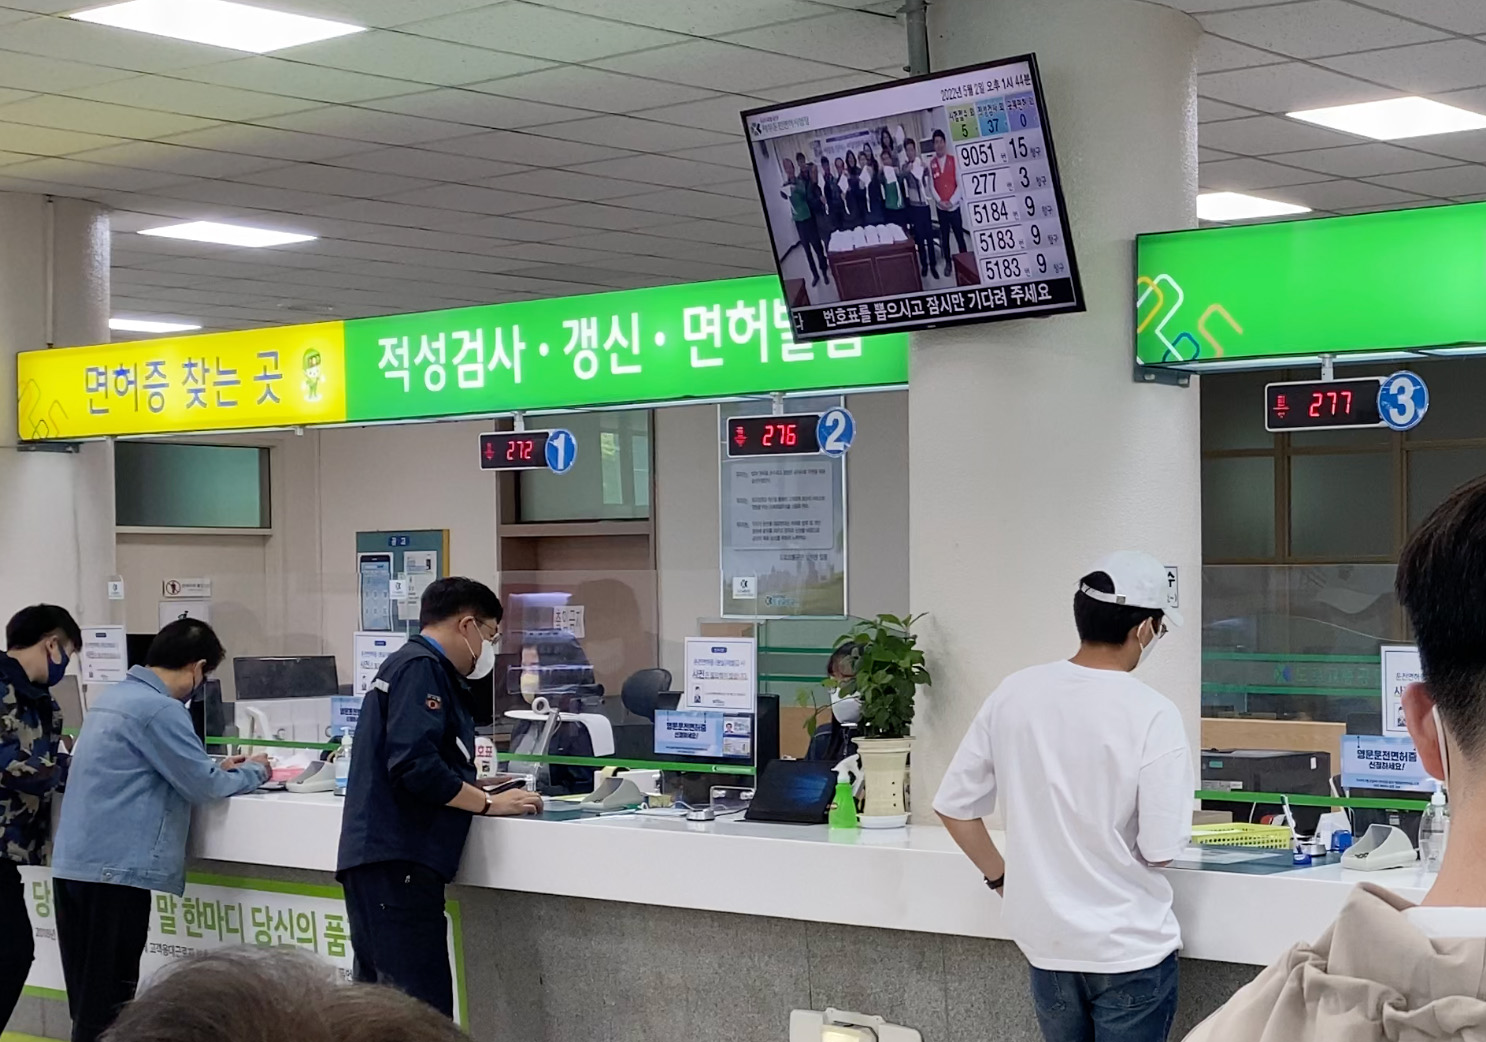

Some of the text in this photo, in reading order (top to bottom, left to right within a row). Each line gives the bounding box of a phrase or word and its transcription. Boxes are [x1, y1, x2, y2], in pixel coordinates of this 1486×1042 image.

[987, 79, 1000, 92] 오후
[1002, 76, 1013, 89] 1시
[961, 124, 968, 137] 5
[987, 119, 999, 133] 37
[961, 143, 995, 167] 9051
[1009, 137, 1028, 159] 15
[972, 172, 996, 195] 277
[1019, 167, 1030, 188] 3
[973, 200, 1008, 224] 5184
[1025, 196, 1035, 216] 9
[980, 229, 1015, 252] 5183
[1031, 224, 1041, 245] 9
[986, 258, 1021, 280] 5183
[1036, 253, 1047, 274] 9
[823, 304, 871, 328] 번호표를
[874, 300, 925, 321] 뽑으시고
[927, 294, 965, 316] 잠시만
[968, 288, 1006, 310] 기다려
[1010, 283, 1052, 305] 주세요
[85, 350, 283, 414] 면허증 찾는 곳
[1309, 376, 1415, 425] 277 3
[762, 410, 846, 451] 276 2
[506, 440, 533, 461] 272
[156, 894, 177, 936] 말
[181, 897, 245, 944] 한마디
[251, 906, 319, 953] 당신의
[324, 913, 351, 958] 품
